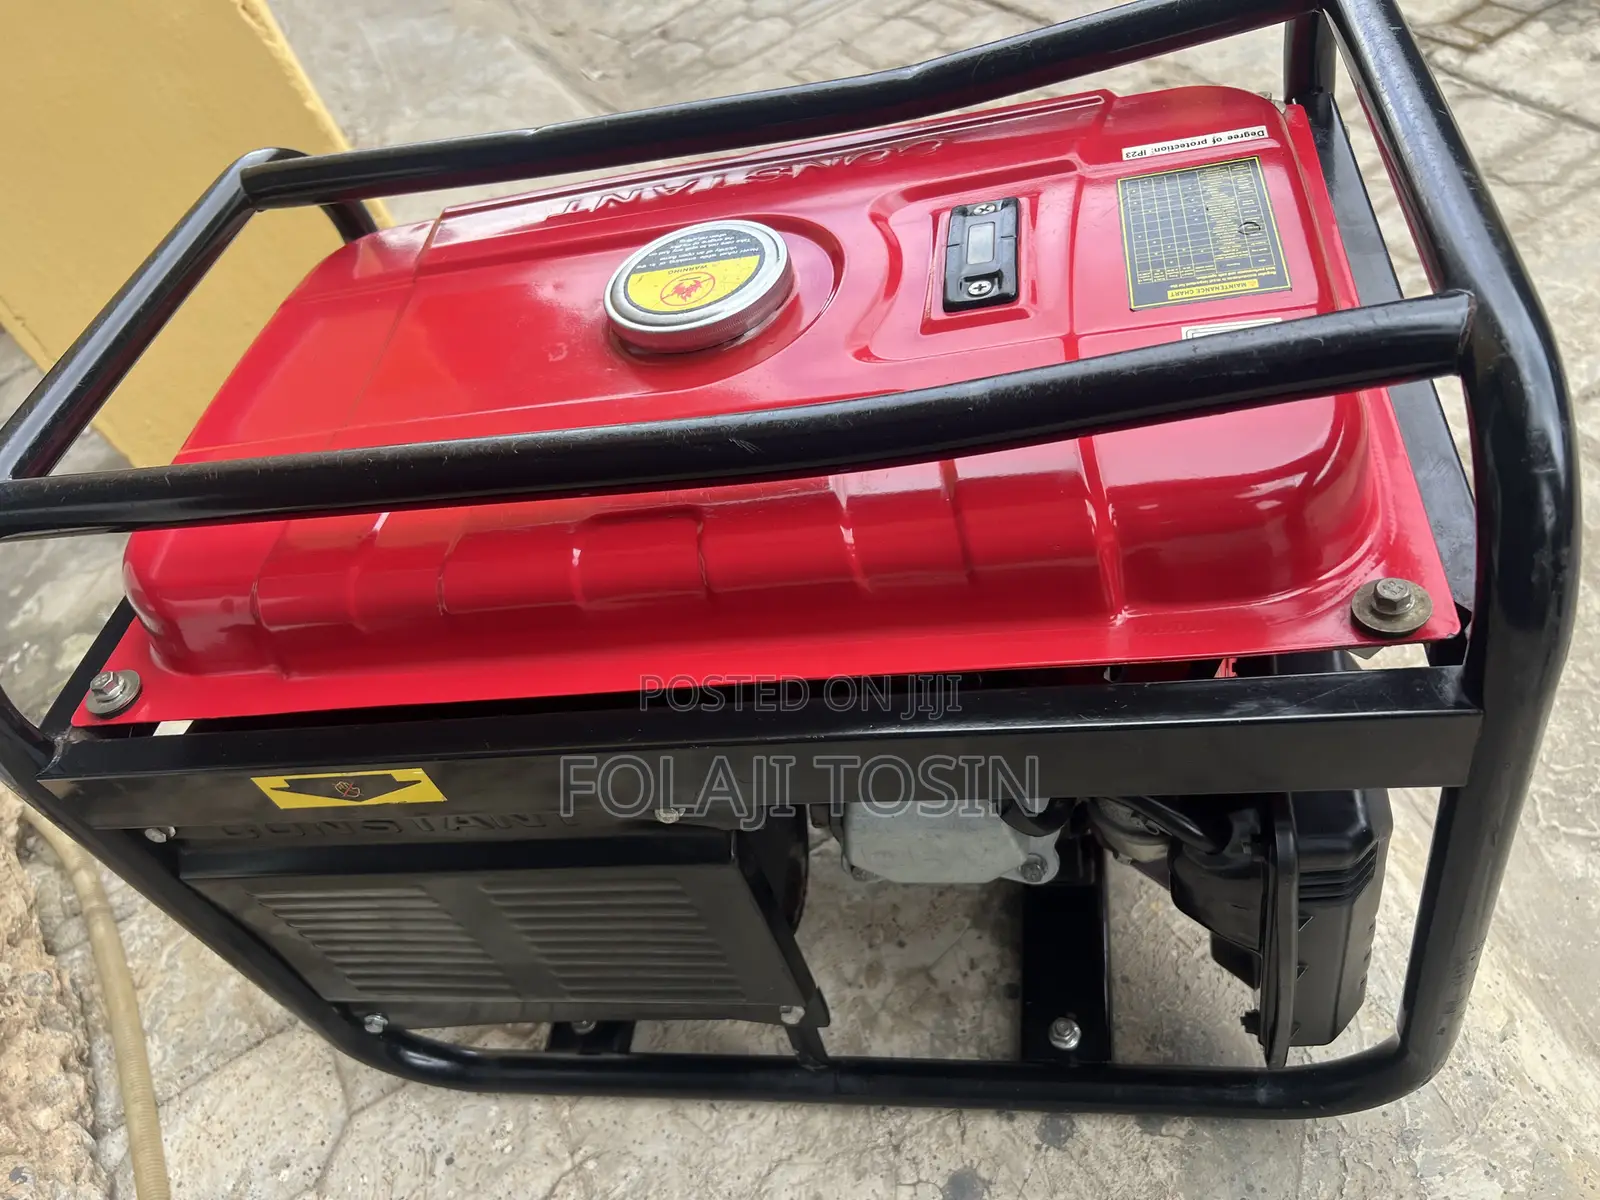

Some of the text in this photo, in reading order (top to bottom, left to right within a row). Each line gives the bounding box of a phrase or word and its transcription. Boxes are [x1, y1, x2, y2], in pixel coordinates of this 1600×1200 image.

[1228, 130, 1265, 140] Degree
[1212, 136, 1222, 145] of
[1126, 150, 1147, 158] IP23
[548, 138, 943, 218] CONSTANT
[668, 264, 708, 274] WARNING
[1196, 282, 1247, 295] MAINTENANCE
